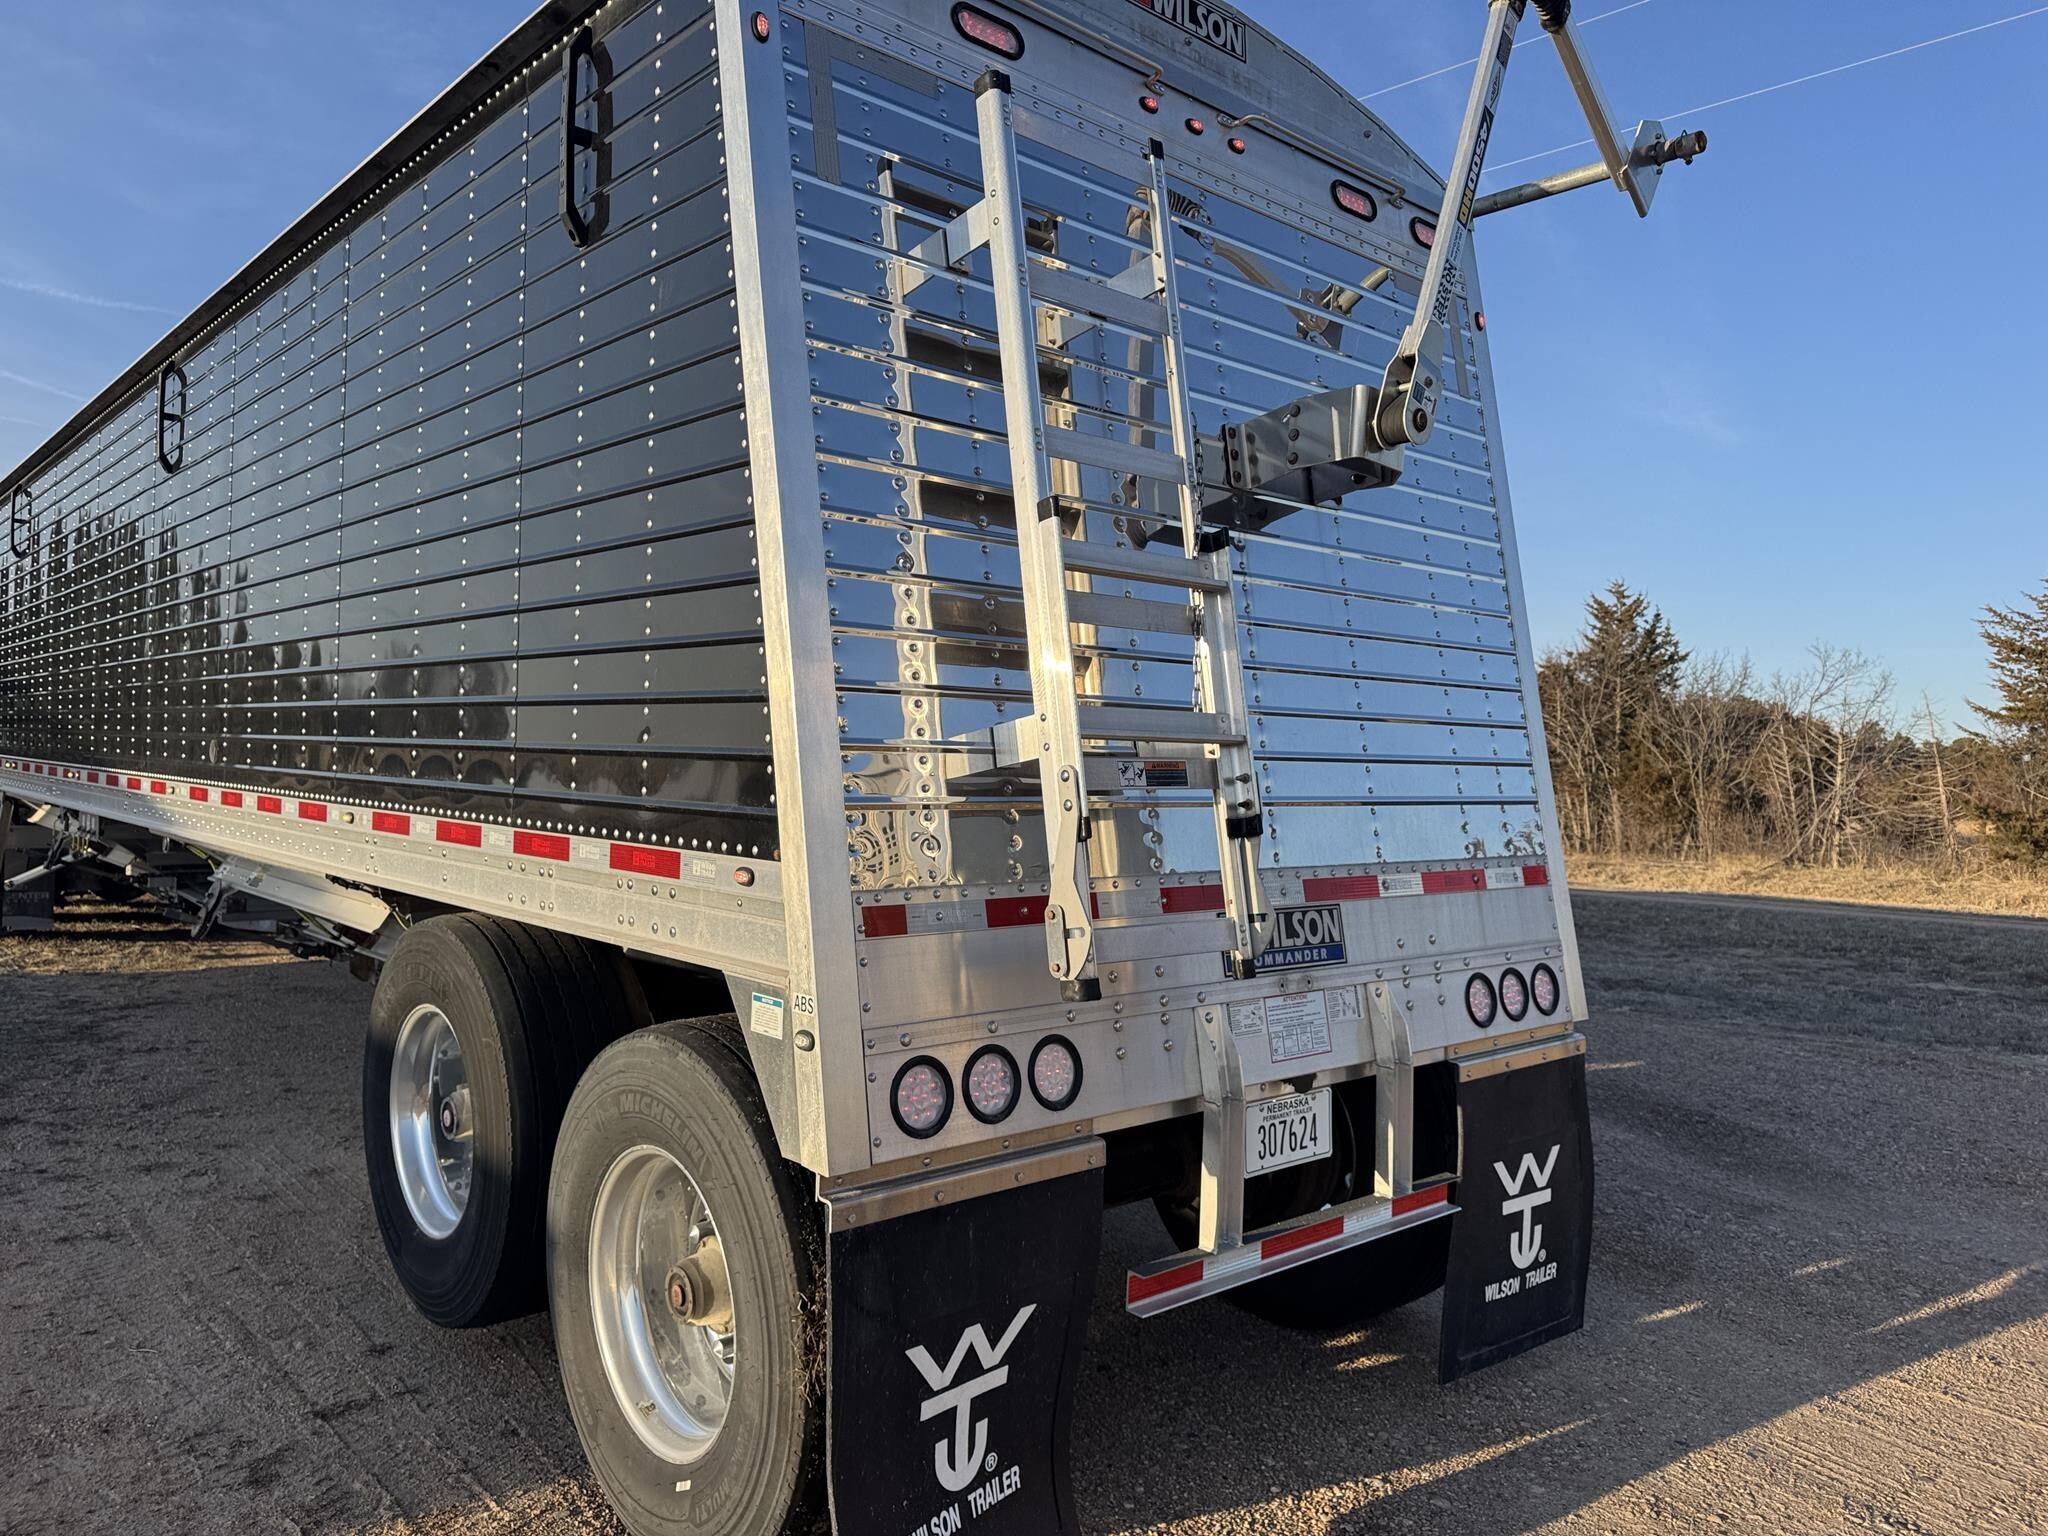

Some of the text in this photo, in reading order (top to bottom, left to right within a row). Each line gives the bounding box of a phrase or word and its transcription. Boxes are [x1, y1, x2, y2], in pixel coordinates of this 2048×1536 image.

[1436, 261, 1456, 320] NO STEP
[1266, 909, 1341, 949] ILSON
[1253, 947, 1328, 967] OMMANDER
[793, 994, 814, 1015] ABS
[1262, 1106, 1313, 1123] PERMANENT TRAILER
[1266, 1097, 1310, 1115] NEBRASKA
[620, 1092, 705, 1165] MICHELIN
[1257, 1112, 1318, 1161] 307624
[1484, 1261, 1558, 1303] WILSON TRAILER
[967, 1464, 1022, 1519] TRAILER
